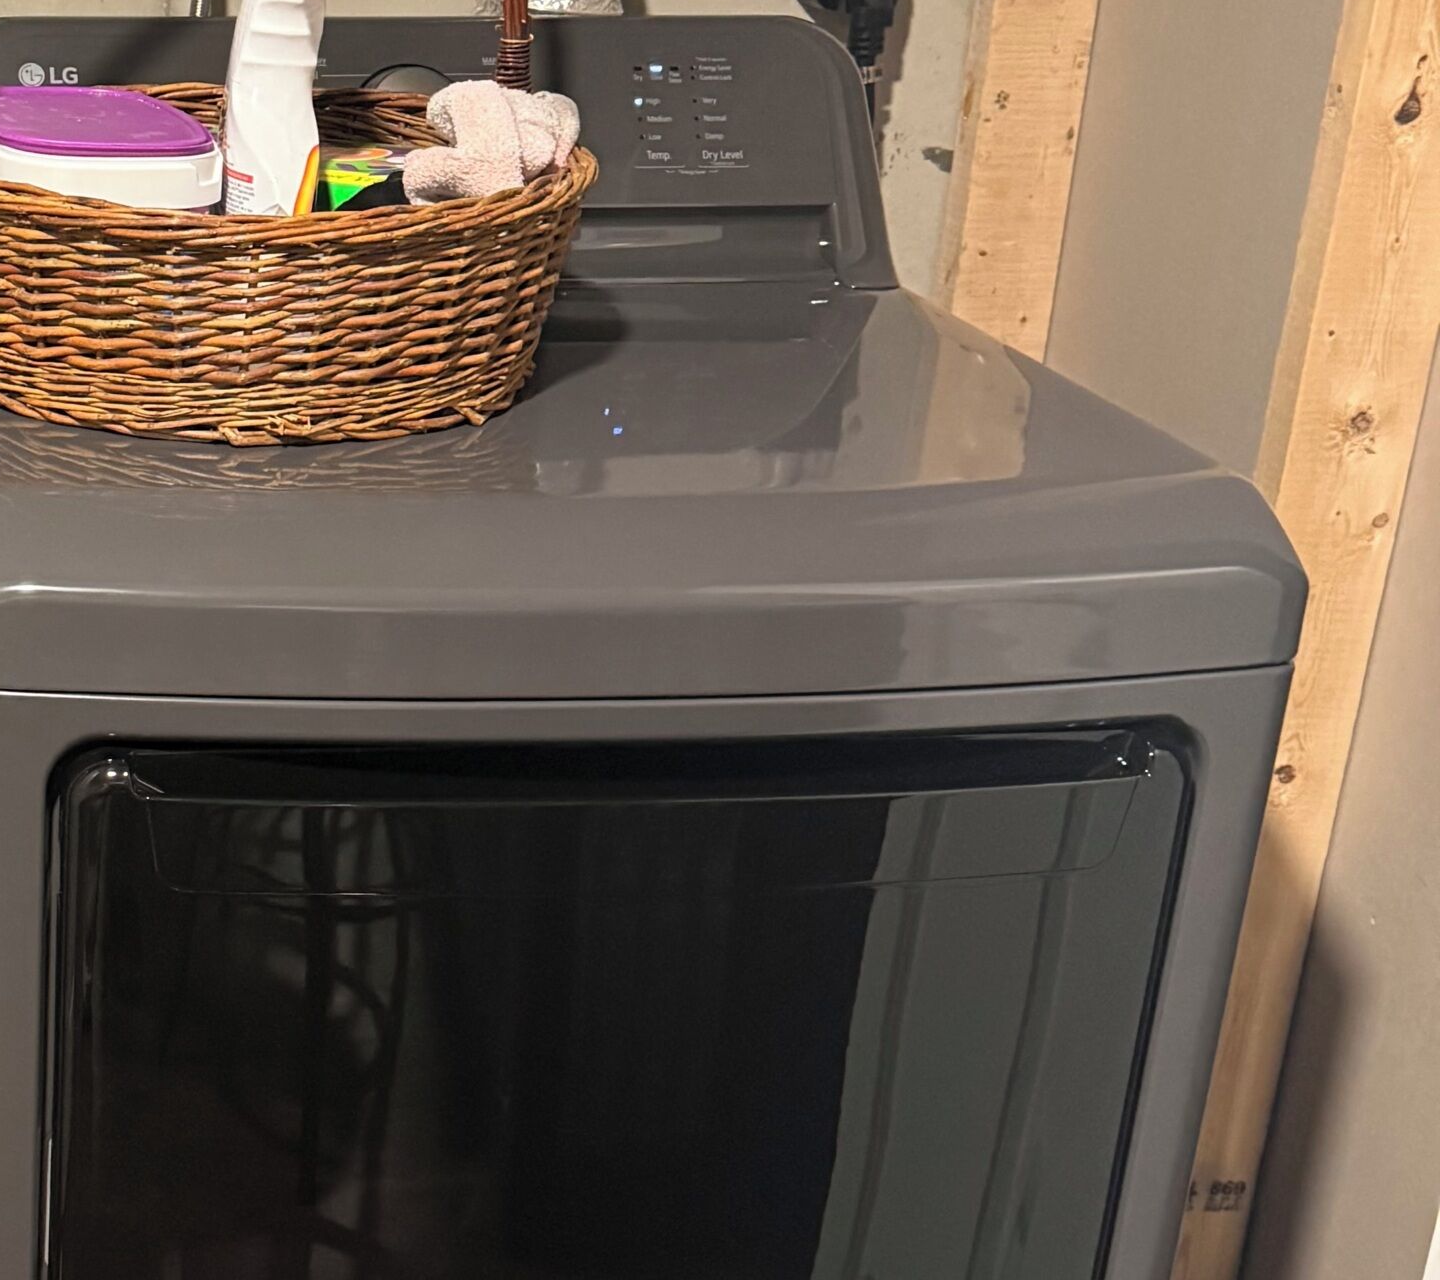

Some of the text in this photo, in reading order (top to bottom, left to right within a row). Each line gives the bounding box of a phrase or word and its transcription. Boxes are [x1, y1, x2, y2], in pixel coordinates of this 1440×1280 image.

[49, 66, 79, 84] LG
[702, 150, 744, 162] Dry Level
